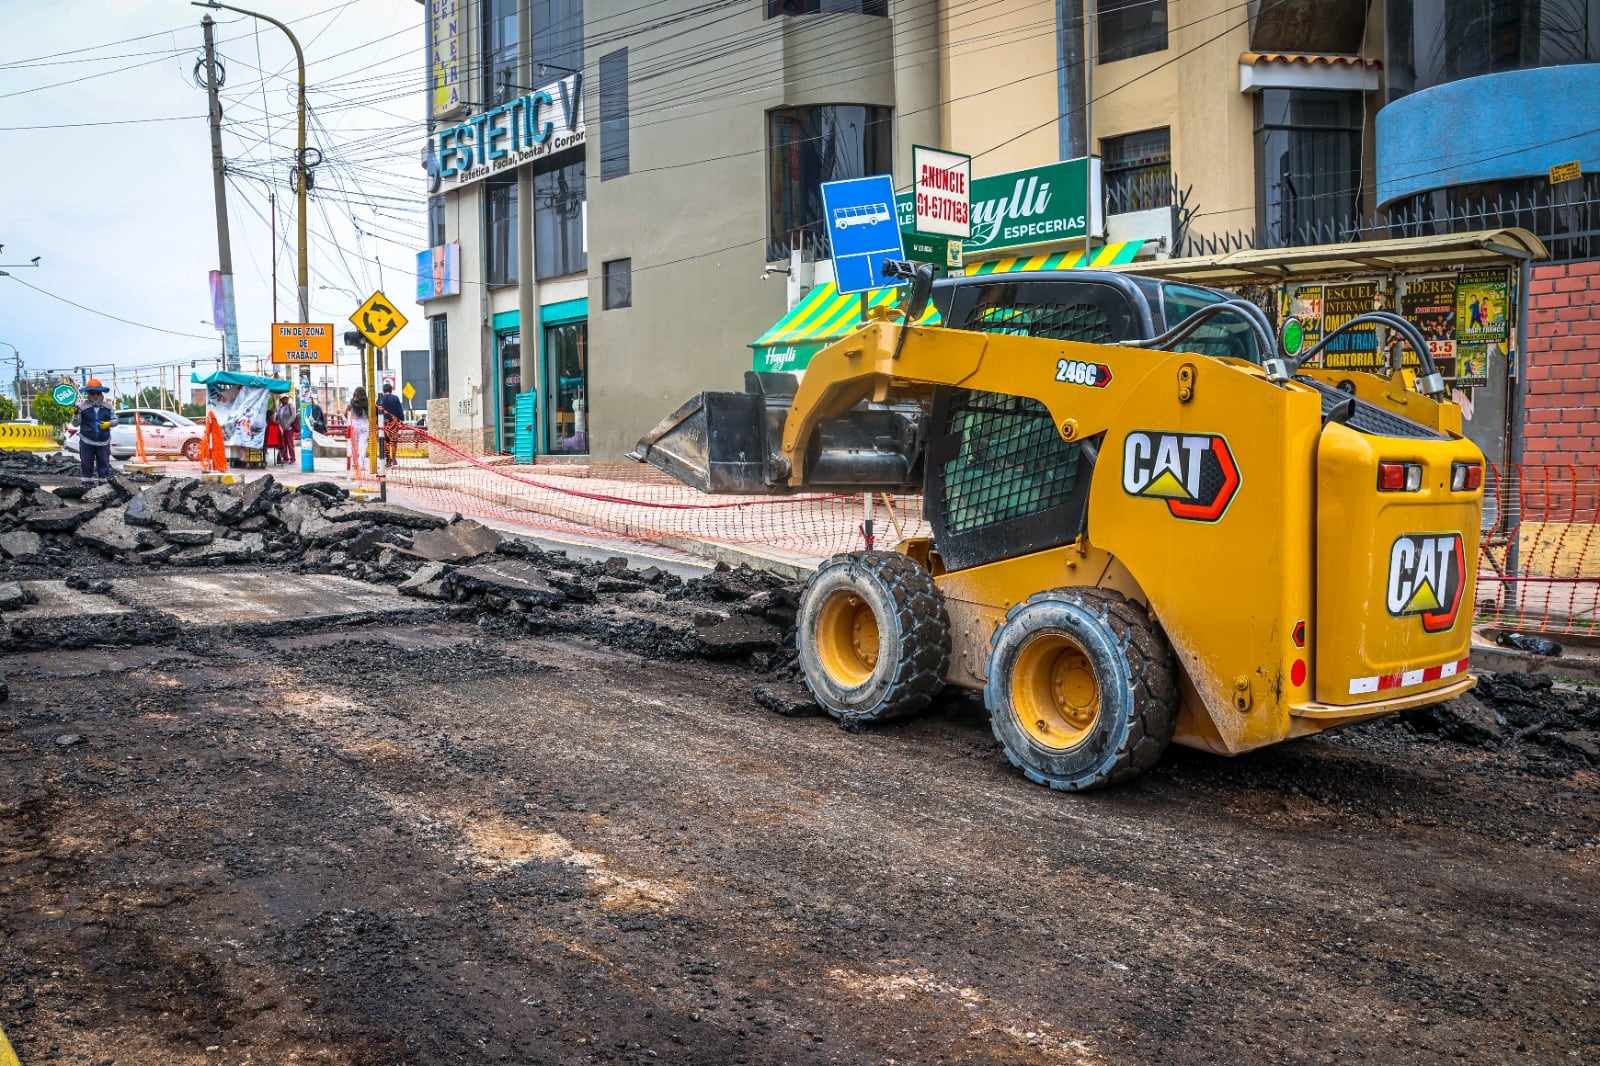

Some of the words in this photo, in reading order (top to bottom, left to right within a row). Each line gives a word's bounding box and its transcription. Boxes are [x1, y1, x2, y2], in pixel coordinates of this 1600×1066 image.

[440, 90, 554, 178] ESTETIC
[492, 154, 518, 173] Facial,
[518, 143, 545, 162] Dental
[546, 141, 553, 154] y
[555, 131, 587, 149] Corpor
[921, 164, 965, 194] ANUNCIE
[897, 201, 913, 213] TO
[916, 192, 968, 224] 01-6717183
[1004, 215, 1085, 239] ESPECERIAS
[1327, 286, 1375, 300] ESCUEL
[279, 327, 291, 336] FIN
[293, 327, 302, 336] DE
[305, 327, 325, 336] ZONA
[299, 339, 308, 348] DE
[286, 351, 318, 360] TRABAJO
[765, 346, 797, 371] Haylli
[1429, 341, 1438, 353] 3
[1444, 341, 1452, 352] 5
[1326, 353, 1374, 367] ORATORIA
[1056, 359, 1097, 386] 246C
[56, 389, 73, 401] SIGA
[1123, 432, 1210, 500] CAT
[1387, 537, 1455, 613] CAT
